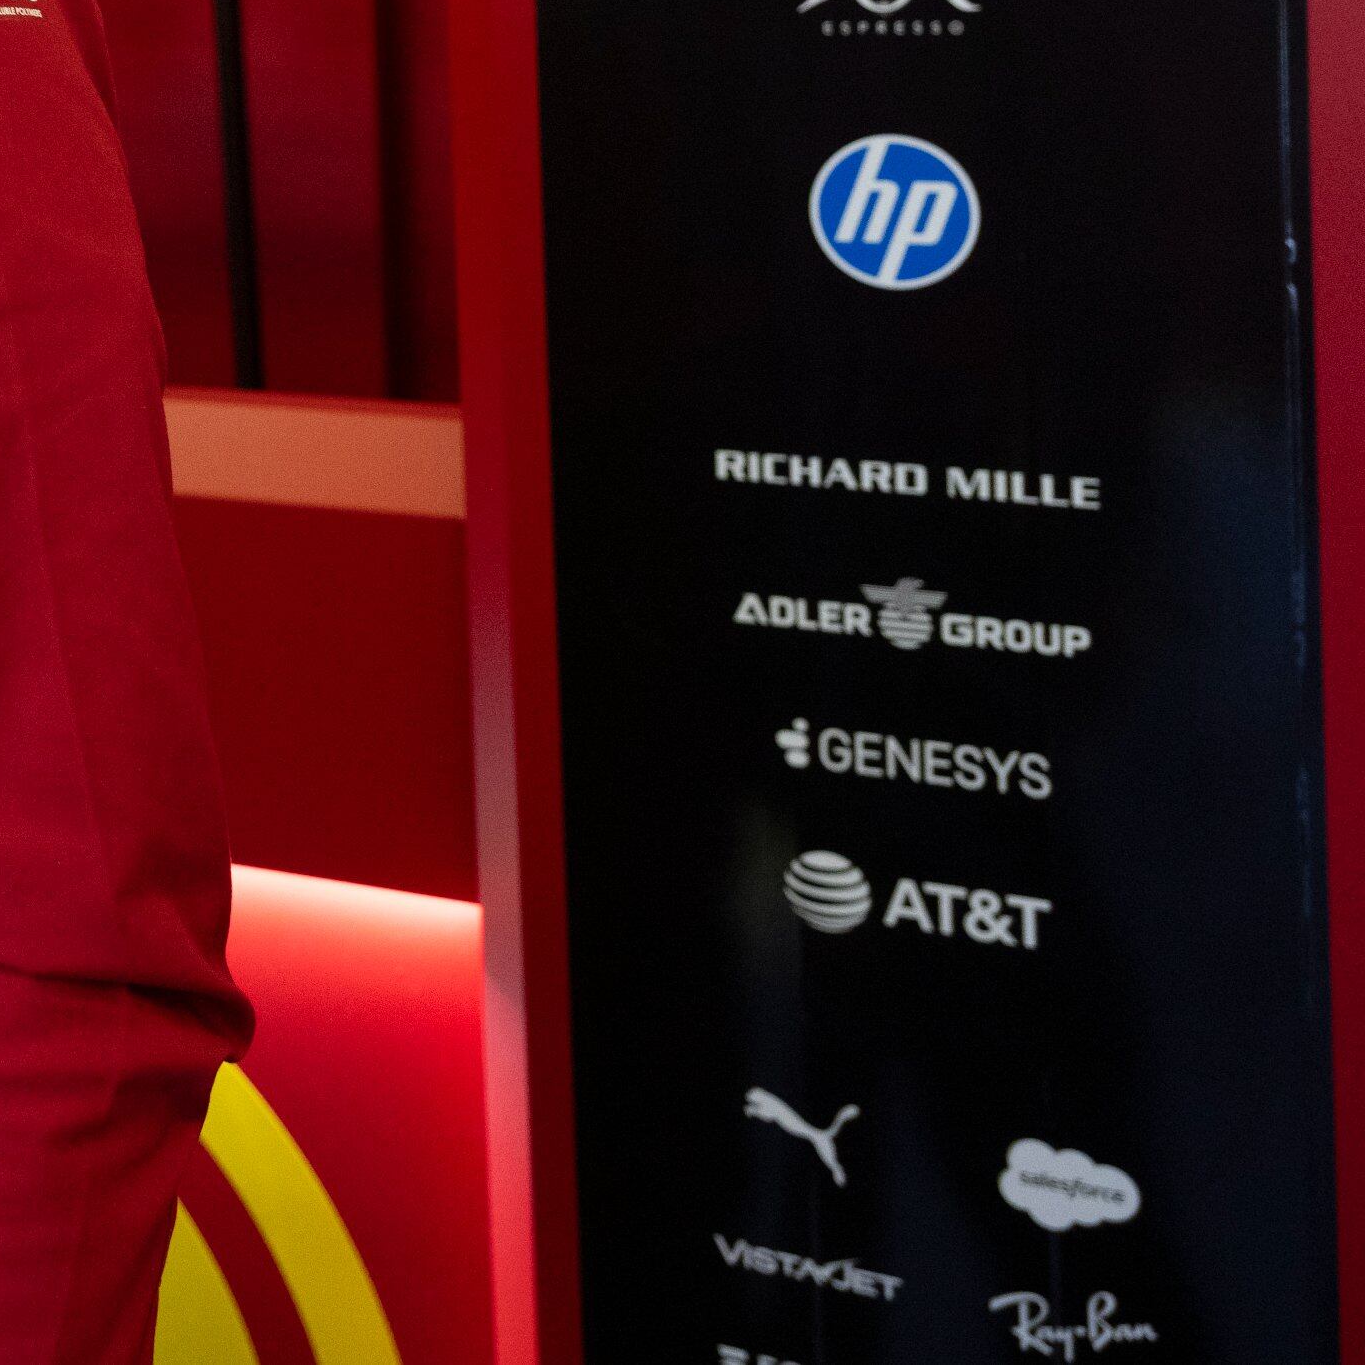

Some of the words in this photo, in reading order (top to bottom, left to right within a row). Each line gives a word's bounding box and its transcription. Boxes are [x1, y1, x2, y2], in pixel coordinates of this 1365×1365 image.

[834, 140, 957, 283] hp
[714, 448, 929, 496] RICHARD
[946, 465, 1102, 511] MILLE
[733, 591, 874, 636] ADLER
[939, 612, 1092, 659] GROUP
[817, 727, 1053, 800] GENESYS
[882, 877, 1053, 950] AT&T
[988, 1290, 1158, 1363] Ray-Ban
